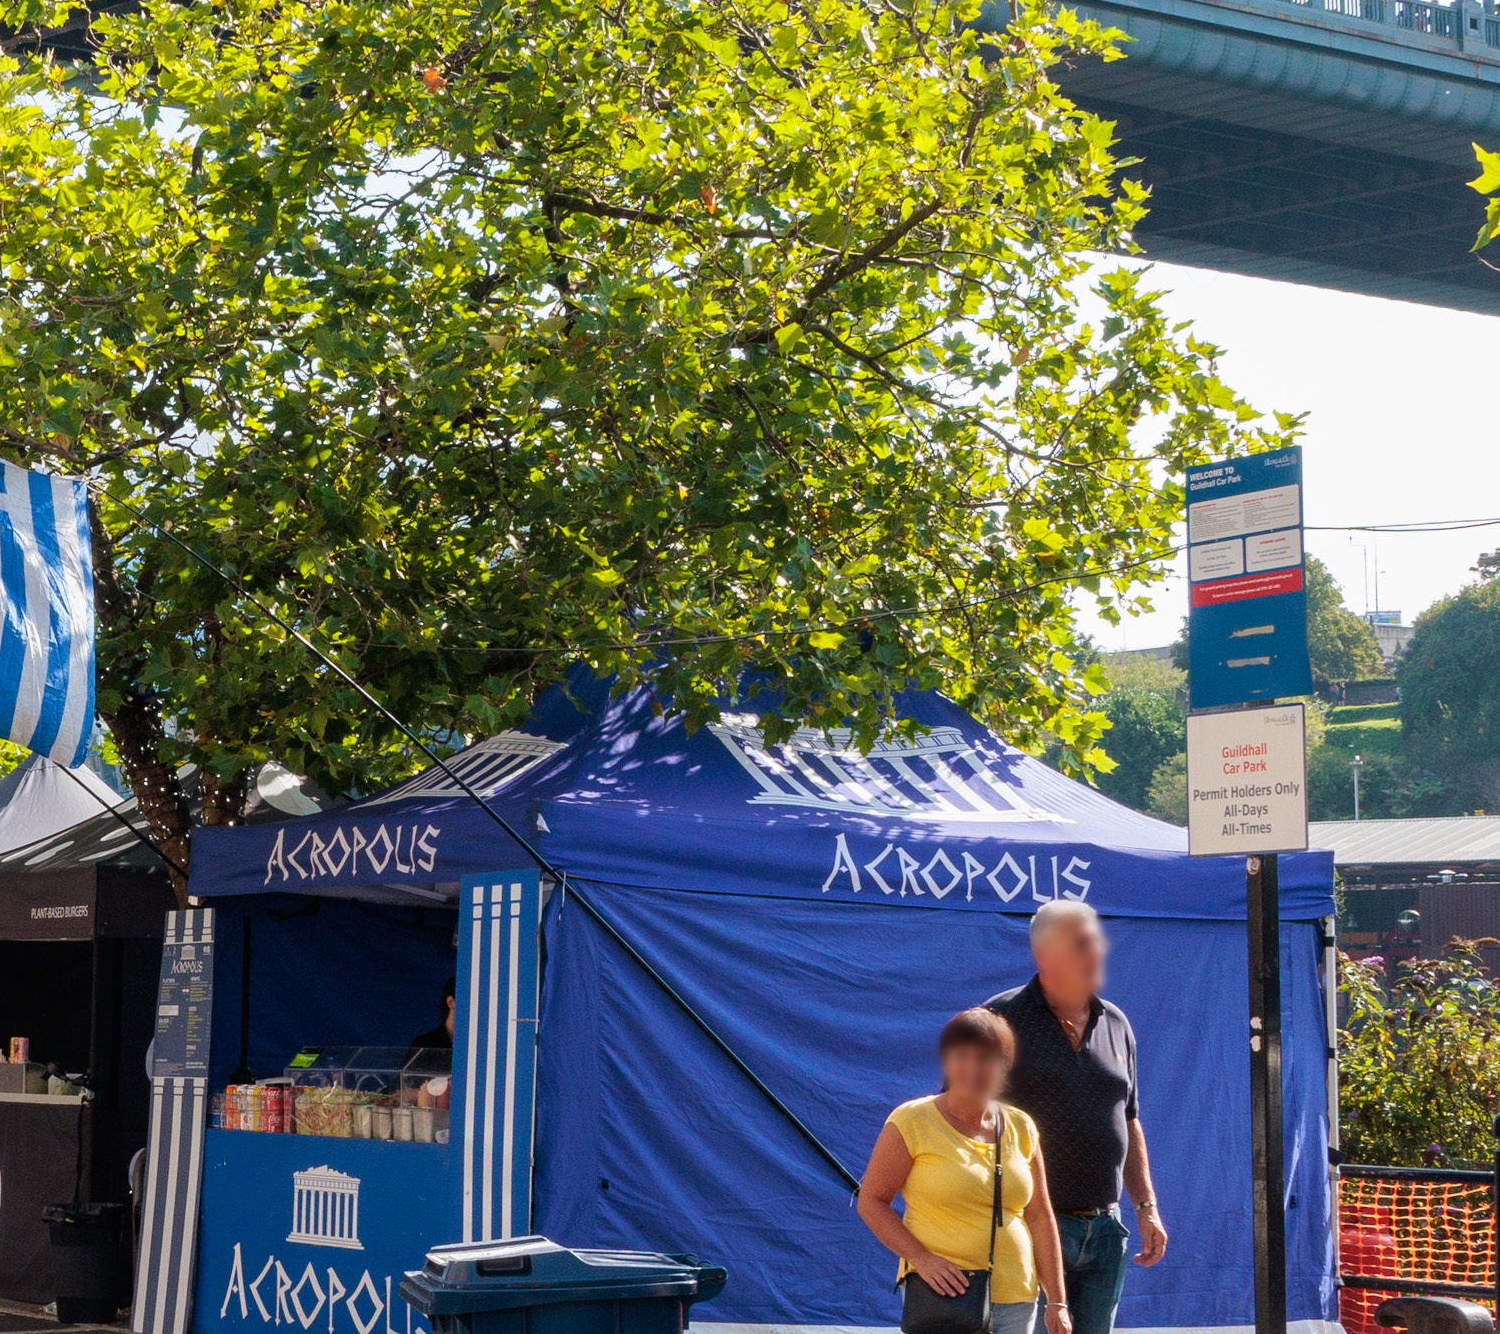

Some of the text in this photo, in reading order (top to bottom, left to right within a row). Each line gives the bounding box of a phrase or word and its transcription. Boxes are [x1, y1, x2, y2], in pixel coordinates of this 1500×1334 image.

[1190, 466, 1235, 481] WELCOME TO
[1190, 474, 1242, 491] Guildhall Car Park
[1222, 743, 1267, 758] Guildhall
[1223, 759, 1267, 775] Car Park
[1193, 781, 1300, 801] Permit Holders Only
[1224, 804, 1268, 818] All-Days
[1222, 822, 1272, 836] All-Times
[264, 823, 441, 886] ACROPOLIS
[822, 832, 1091, 903] ACROPOLIS
[31, 905, 89, 919] PLANT-BASED BURGERS
